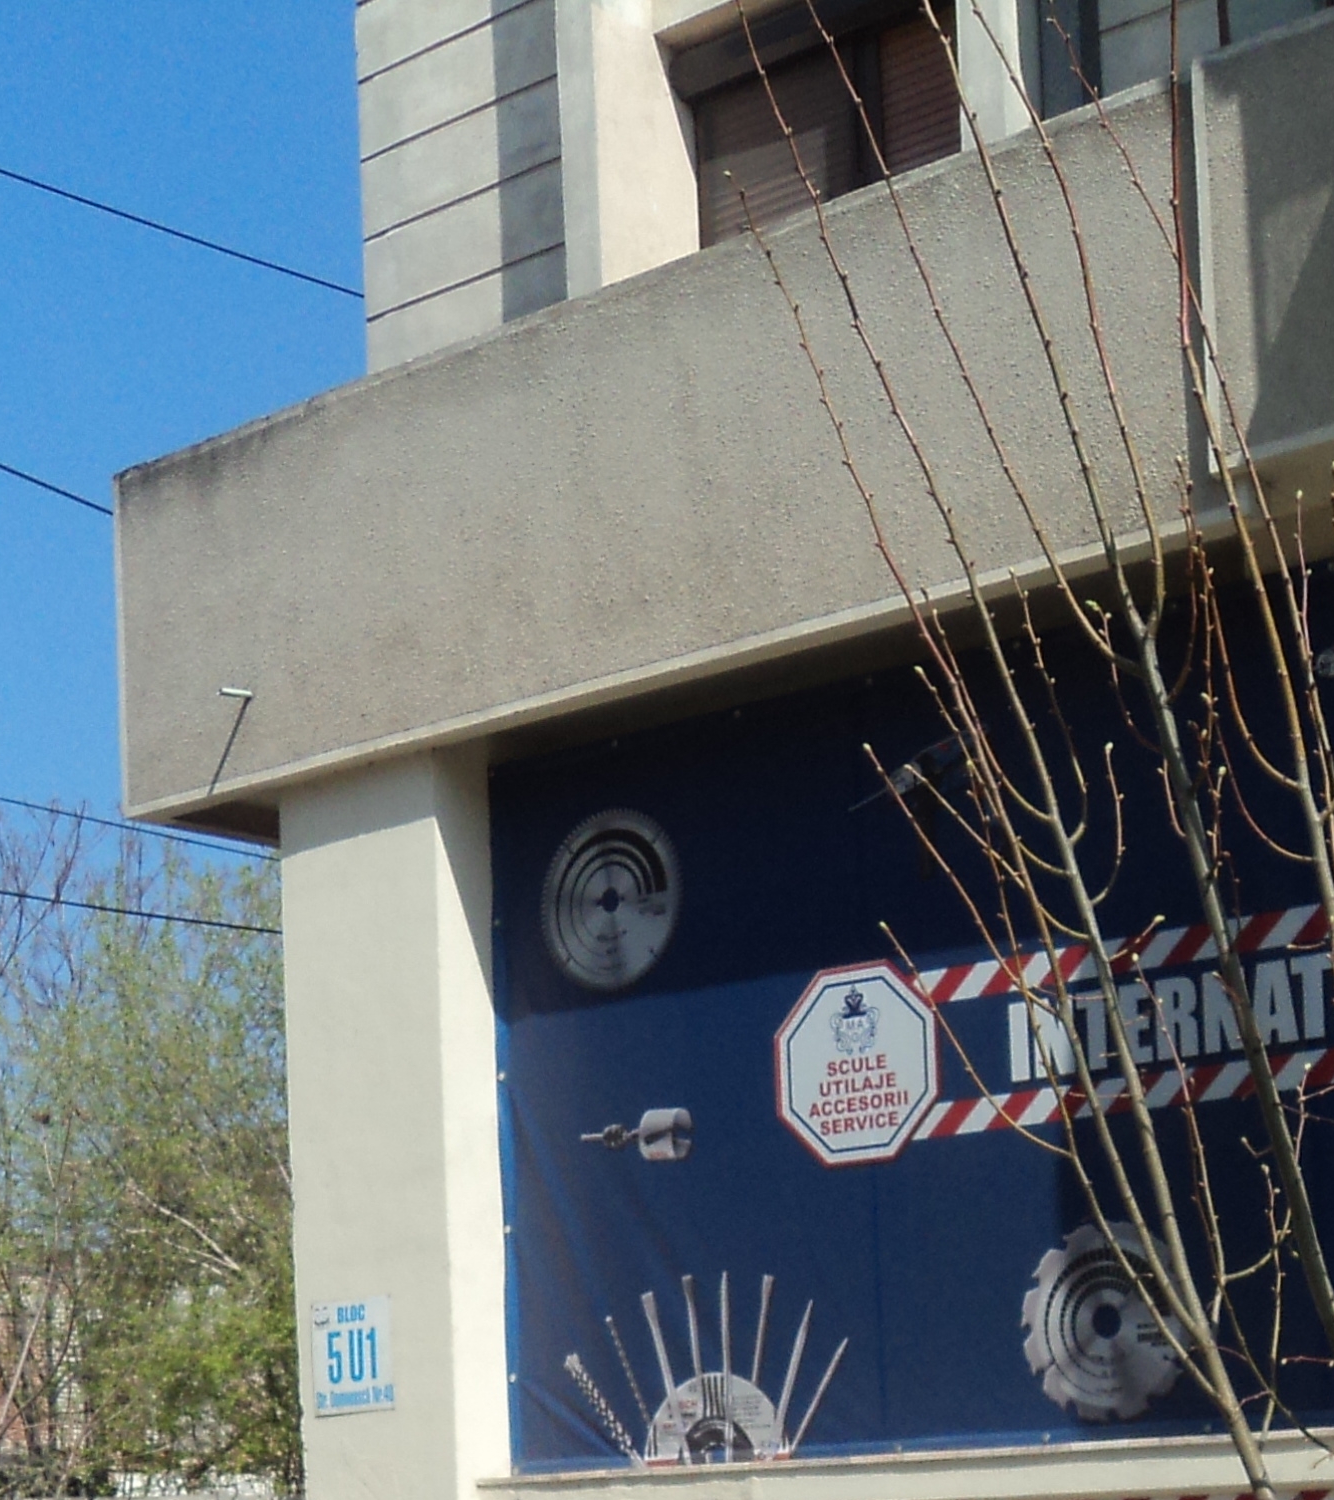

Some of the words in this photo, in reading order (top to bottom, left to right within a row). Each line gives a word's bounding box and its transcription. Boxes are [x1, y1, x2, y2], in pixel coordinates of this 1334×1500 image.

[827, 1054, 887, 1077] SCULE
[819, 1072, 897, 1098] UTILAJE
[809, 1090, 909, 1118] ACCESORII
[820, 1111, 900, 1136] SERVICE
[336, 1303, 366, 1324] BLOC
